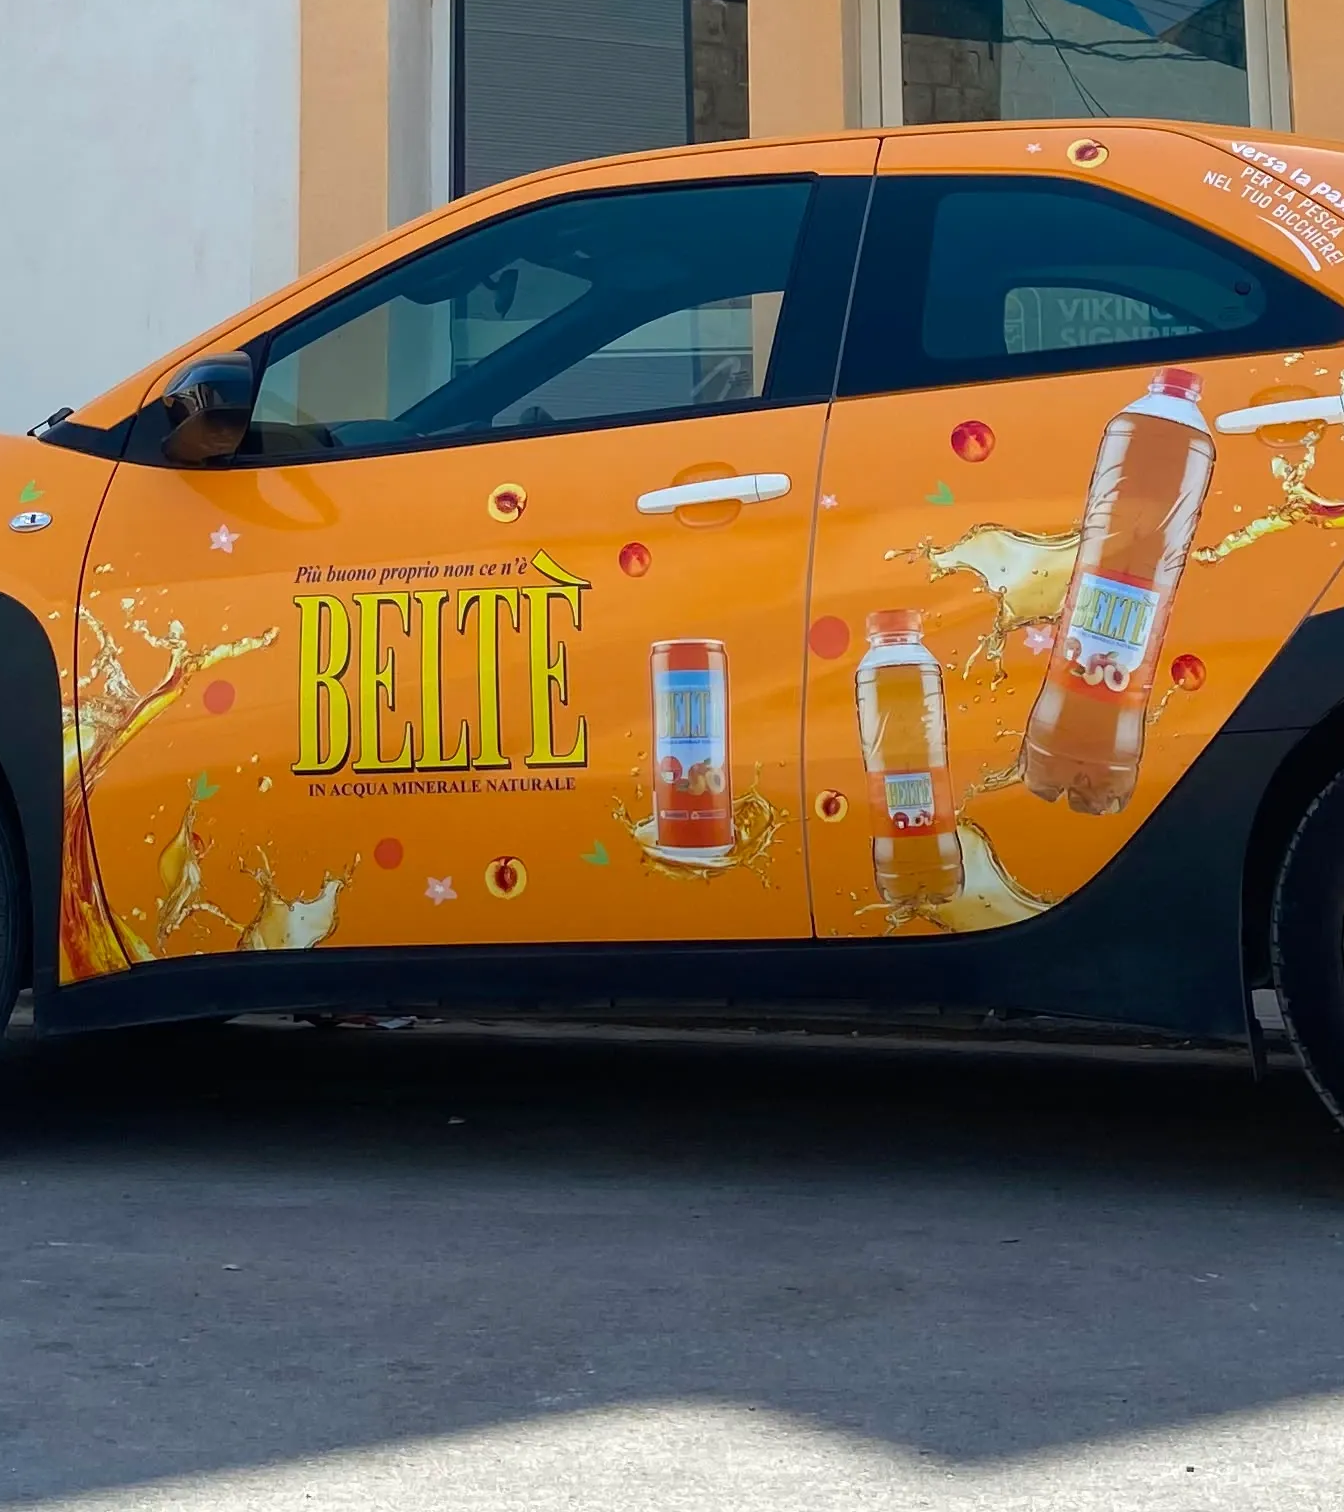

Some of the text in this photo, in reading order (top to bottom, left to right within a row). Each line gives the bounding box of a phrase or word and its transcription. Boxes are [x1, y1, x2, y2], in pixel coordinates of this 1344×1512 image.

[1231, 141, 1287, 175] versa
[1289, 168, 1312, 187] la
[1203, 170, 1232, 192] NEL
[1240, 185, 1273, 209] TUO
[1241, 166, 1344, 239] PER LA PESCA
[294, 565, 321, 583] Più
[326, 565, 376, 583] buono
[379, 561, 439, 585] proprio
[443, 563, 474, 577] non
[479, 562, 497, 576] ce
[291, 549, 592, 776] BELTÈ
[309, 777, 576, 799] IN ACQUA MINERALE NATURALE
